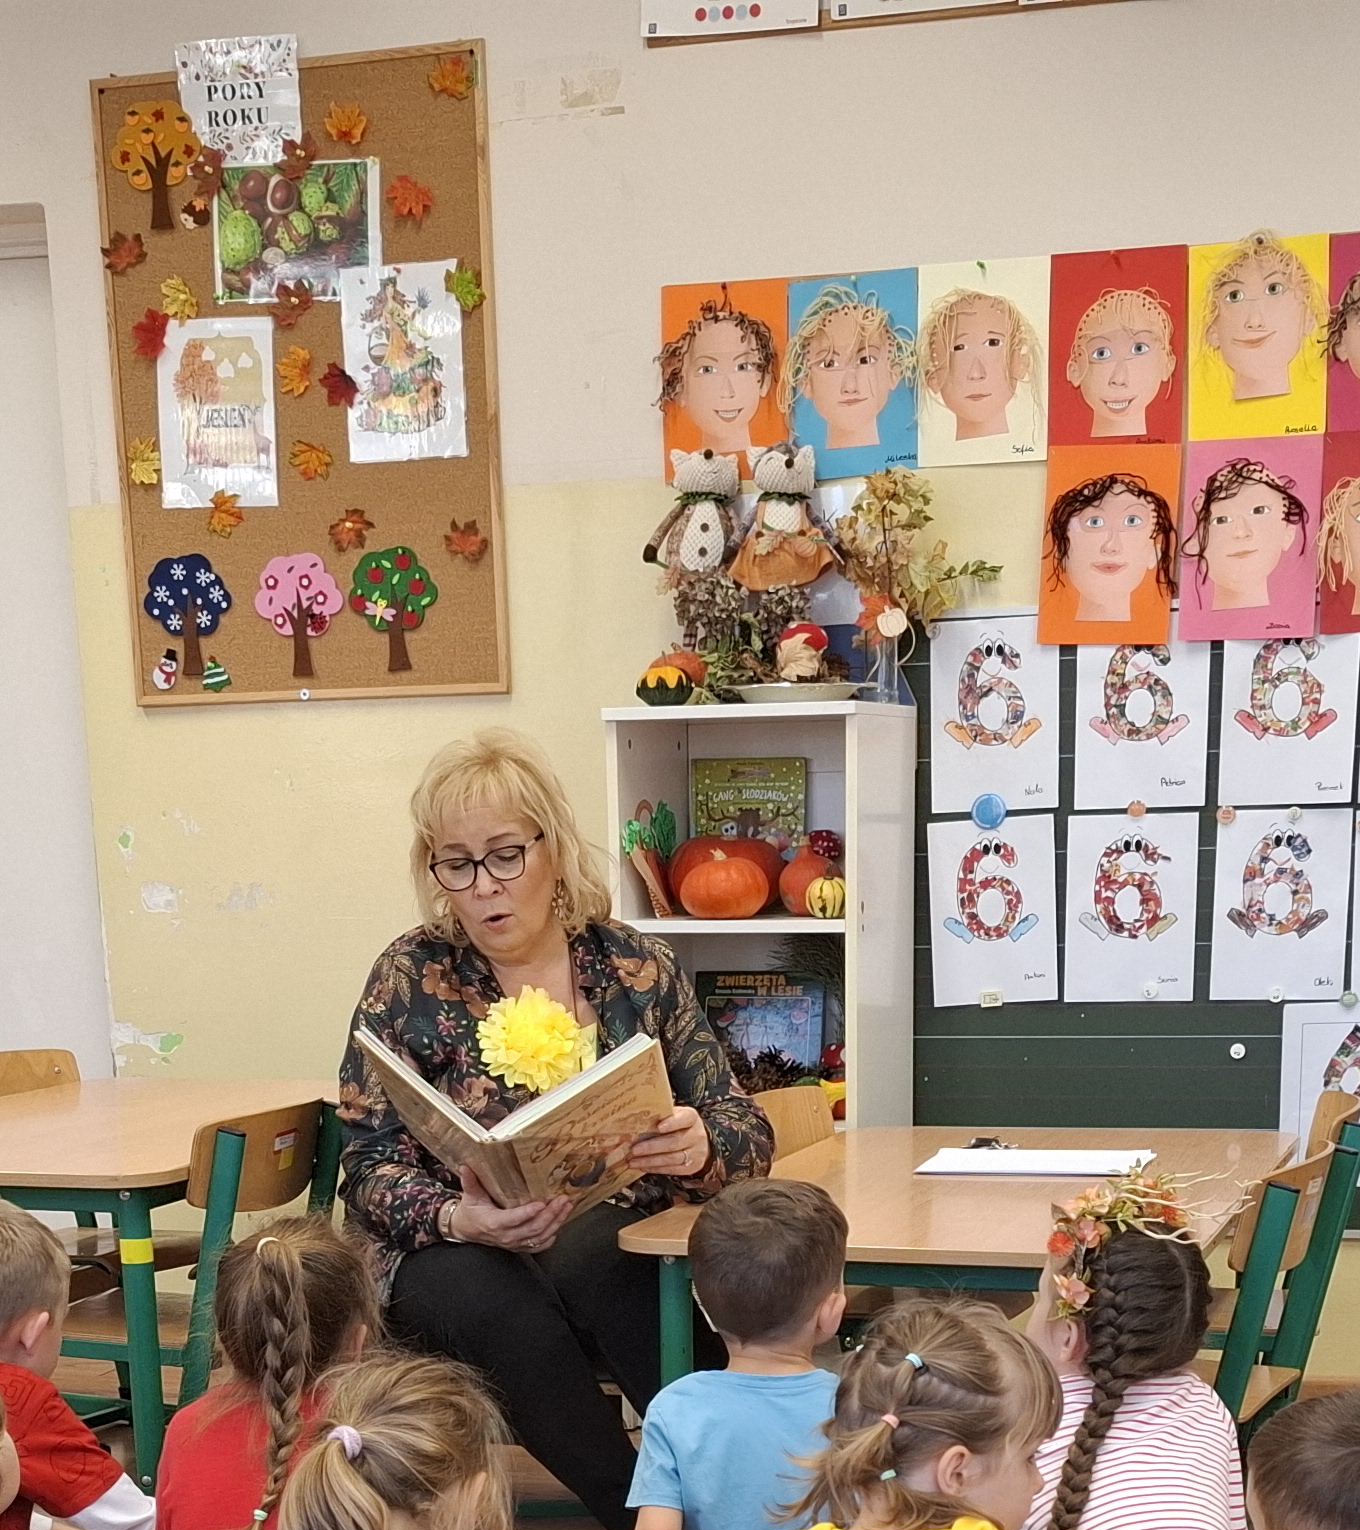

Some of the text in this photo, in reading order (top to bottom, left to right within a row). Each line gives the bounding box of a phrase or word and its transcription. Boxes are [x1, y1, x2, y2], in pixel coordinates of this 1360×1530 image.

[206, 81, 266, 102] PORY
[207, 107, 269, 127] ROKU
[716, 974, 787, 987] ZWIERZĘTA
[757, 986, 767, 996] W
[771, 985, 804, 996] LESIE
